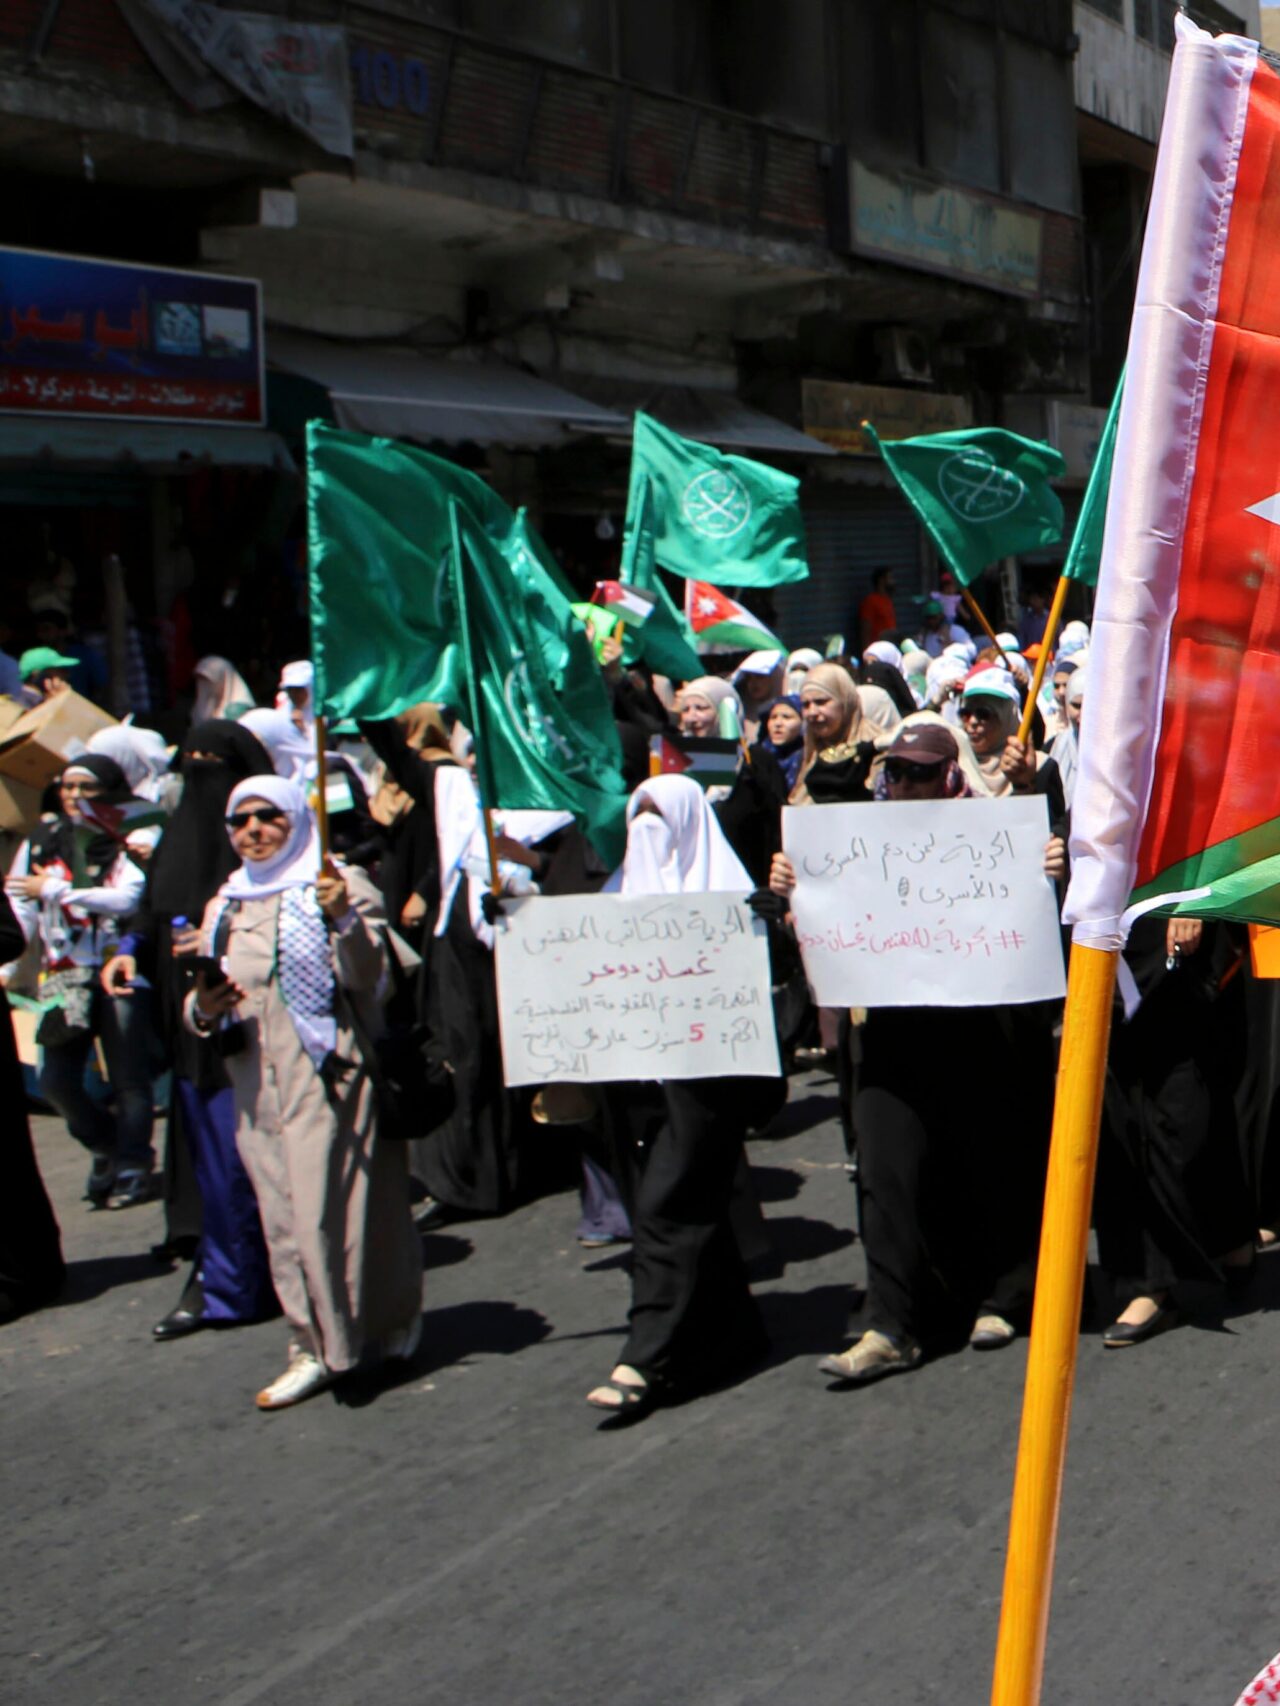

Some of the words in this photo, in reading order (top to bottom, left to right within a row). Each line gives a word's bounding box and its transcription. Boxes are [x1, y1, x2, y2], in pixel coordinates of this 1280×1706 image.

[350, 47, 430, 114] 100
[881, 843, 904, 881] دعم
[908, 833, 935, 863] لمن
[940, 830, 1015, 870] الحرية
[604, 903, 682, 948] للكاتب
[687, 905, 745, 944] الحرية
[594, 991, 657, 1016] المقاومة
[659, 996, 684, 1024] دعم
[688, 1021, 706, 1044] 5
